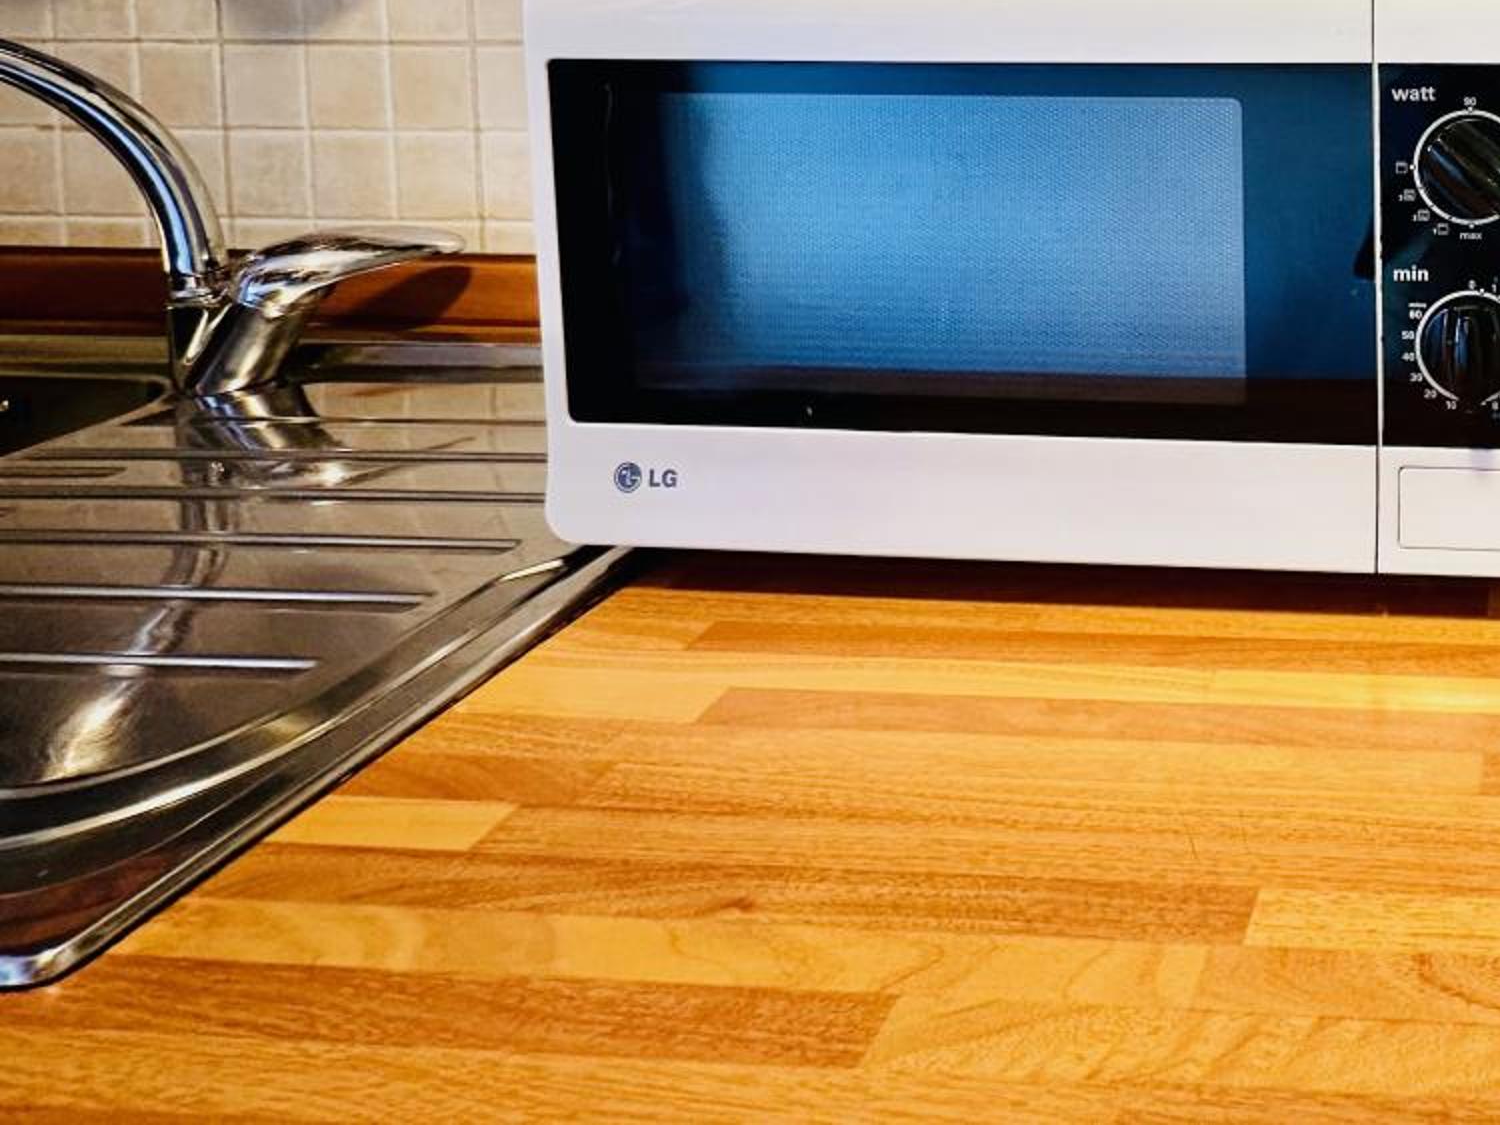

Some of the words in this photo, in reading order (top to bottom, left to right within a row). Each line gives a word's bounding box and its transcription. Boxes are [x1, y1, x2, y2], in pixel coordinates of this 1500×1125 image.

[1391, 86, 1436, 102] watt
[1459, 232, 1483, 241] max
[1393, 265, 1430, 282] min
[648, 468, 678, 487] LG
